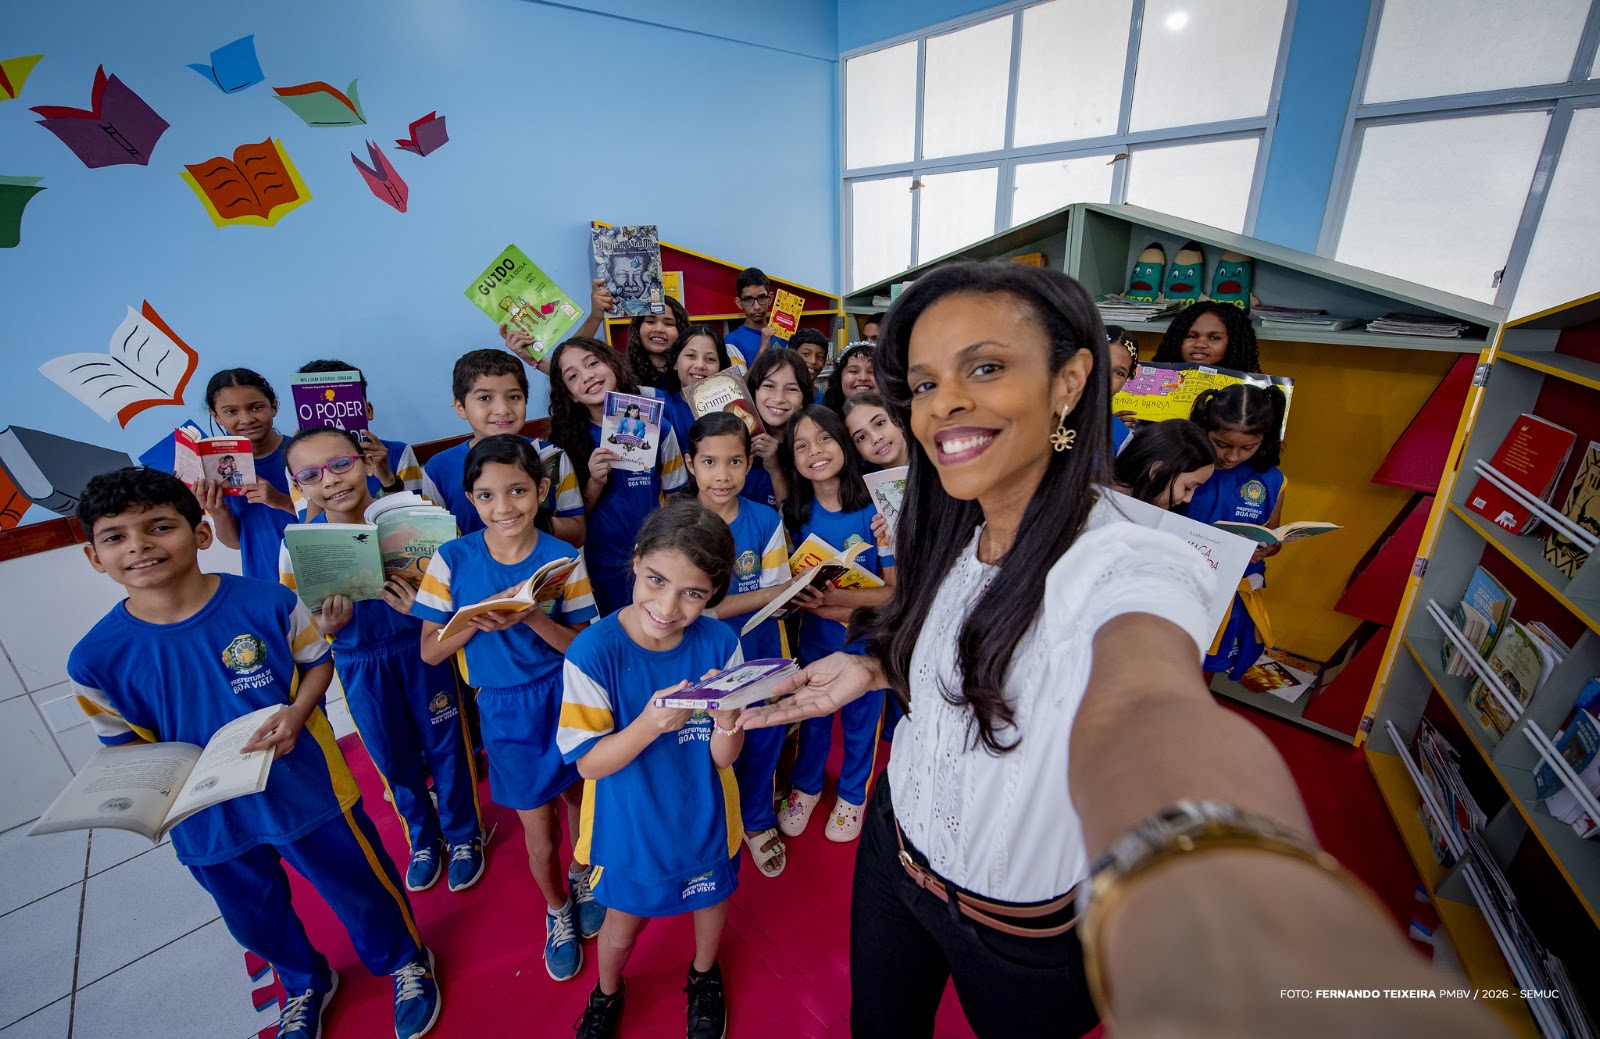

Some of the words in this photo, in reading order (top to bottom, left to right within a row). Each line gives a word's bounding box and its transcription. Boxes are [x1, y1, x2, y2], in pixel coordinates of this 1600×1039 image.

[478, 258, 515, 296] GUIDO
[504, 276, 512, 285] VAI
[513, 262, 527, 276] ESCOLA
[697, 394, 732, 412] Grimm
[300, 404, 312, 420] O
[316, 401, 363, 419] PODER
[405, 544, 437, 555] mági
[230, 673, 265, 686] PREFEITURA
[233, 683, 250, 694] BOA
[252, 675, 274, 688] VISTA
[444, 711, 458, 720] VISTA
[678, 727, 711, 736] PREFEITURA
[679, 733, 695, 744] BOA
[697, 733, 709, 741] VIS
[682, 882, 708, 895] PREFEITURA
[682, 890, 695, 899] BOA
